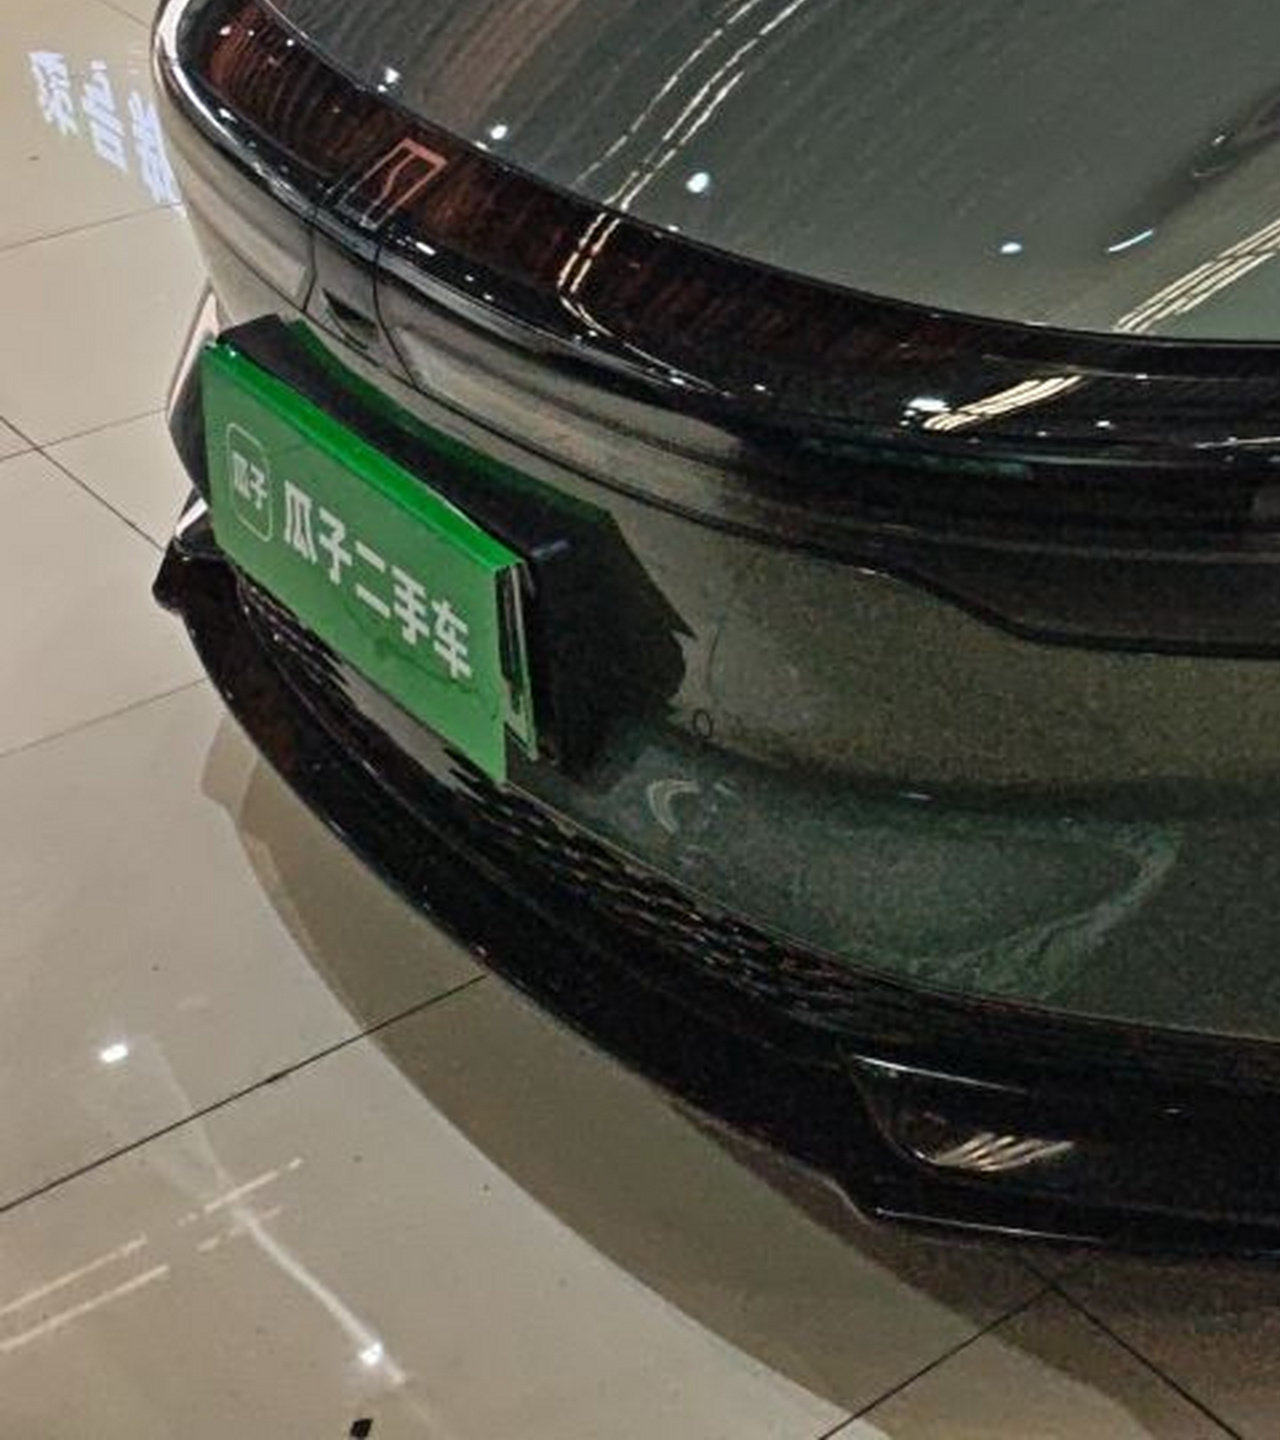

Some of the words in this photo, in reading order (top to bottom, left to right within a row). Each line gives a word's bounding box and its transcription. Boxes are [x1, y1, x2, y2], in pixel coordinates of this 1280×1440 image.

[282, 478, 473, 680] 瓜子二手车
